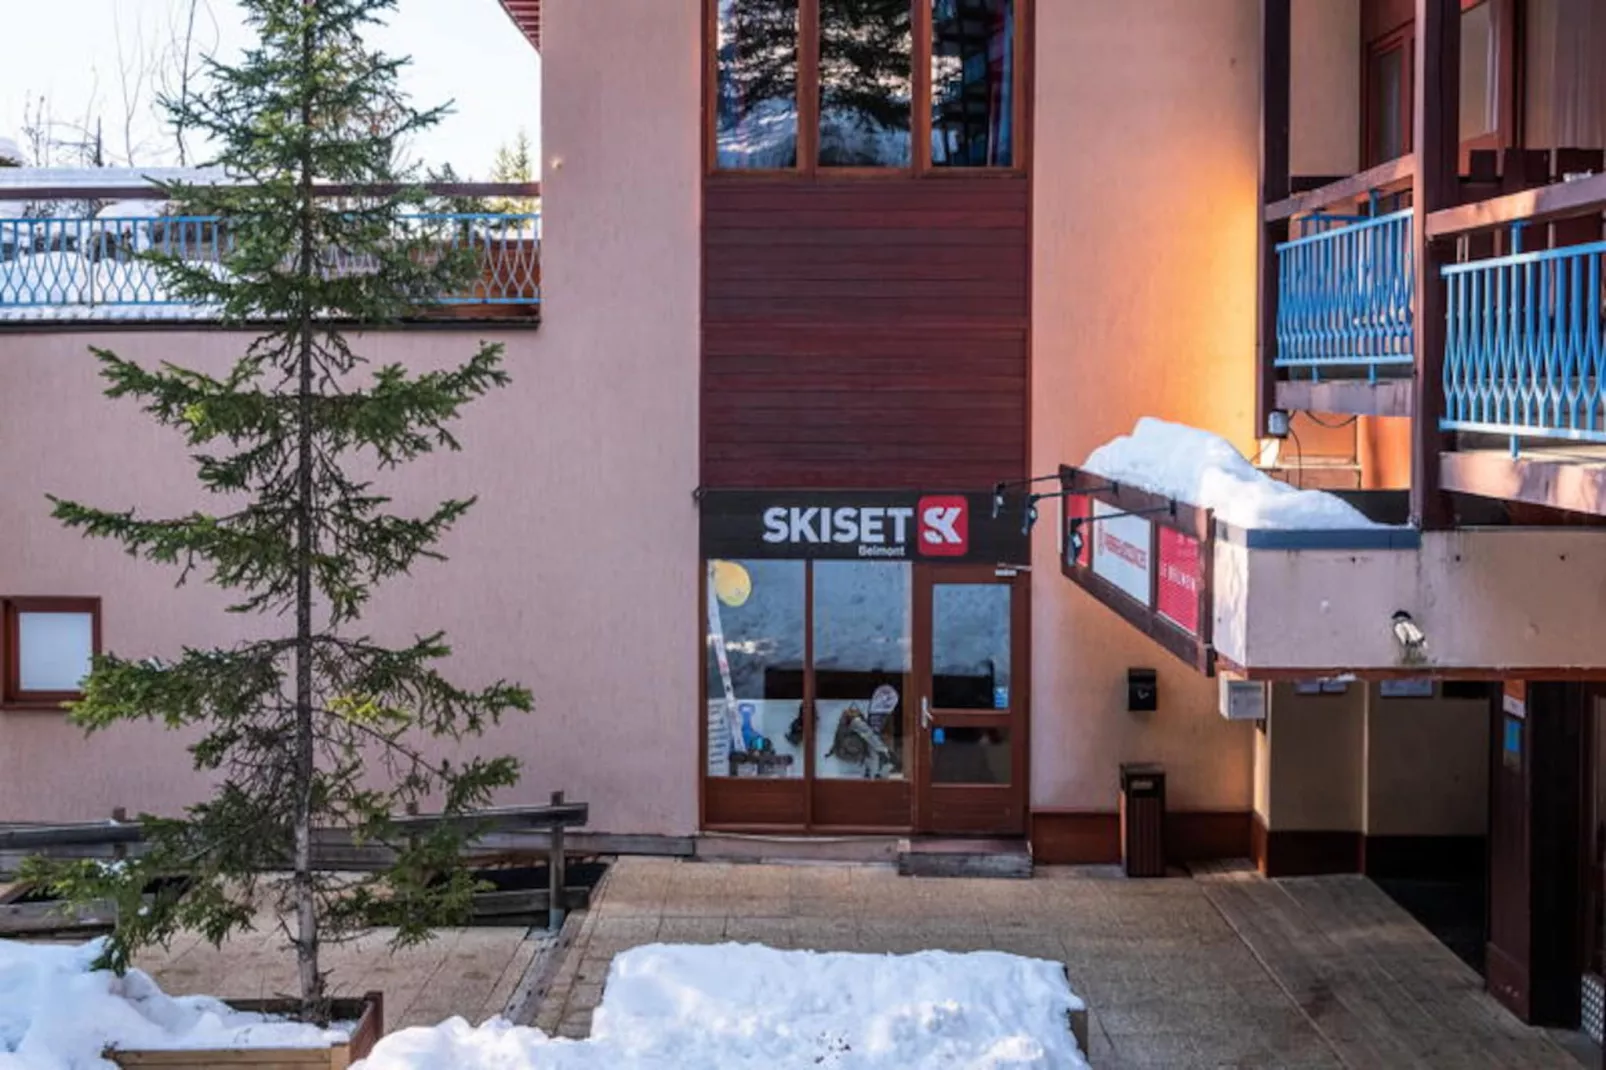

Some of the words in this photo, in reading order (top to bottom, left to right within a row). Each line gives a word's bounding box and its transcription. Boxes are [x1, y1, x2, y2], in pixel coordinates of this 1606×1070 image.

[762, 507, 913, 543] SKISET
[923, 507, 963, 544] SK
[858, 544, 906, 557] Belmont
